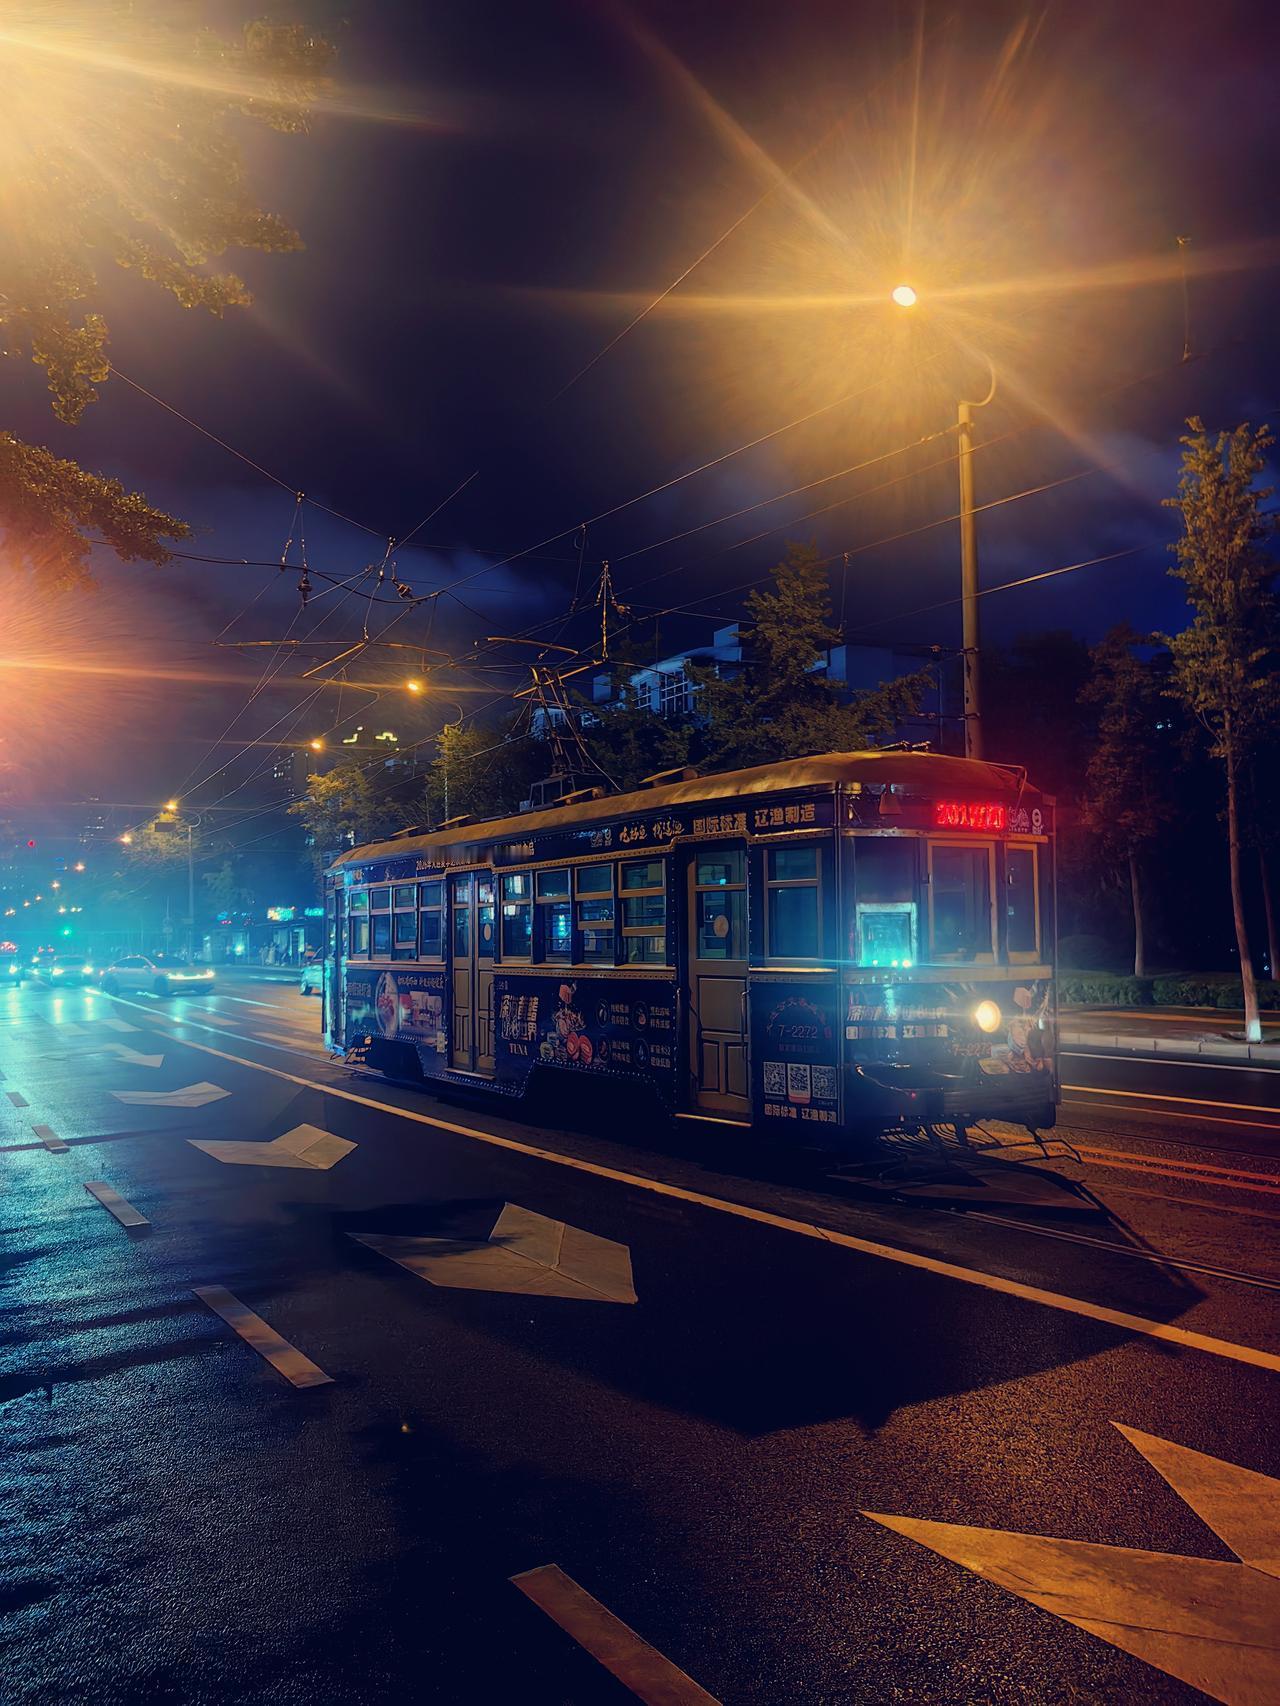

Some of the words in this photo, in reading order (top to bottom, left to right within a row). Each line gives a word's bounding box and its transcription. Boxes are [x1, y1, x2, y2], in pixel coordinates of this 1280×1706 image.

[692, 812, 748, 835] 国际标准
[753, 803, 816, 828] 辽渔制造
[777, 1024, 818, 1039] 7-2272
